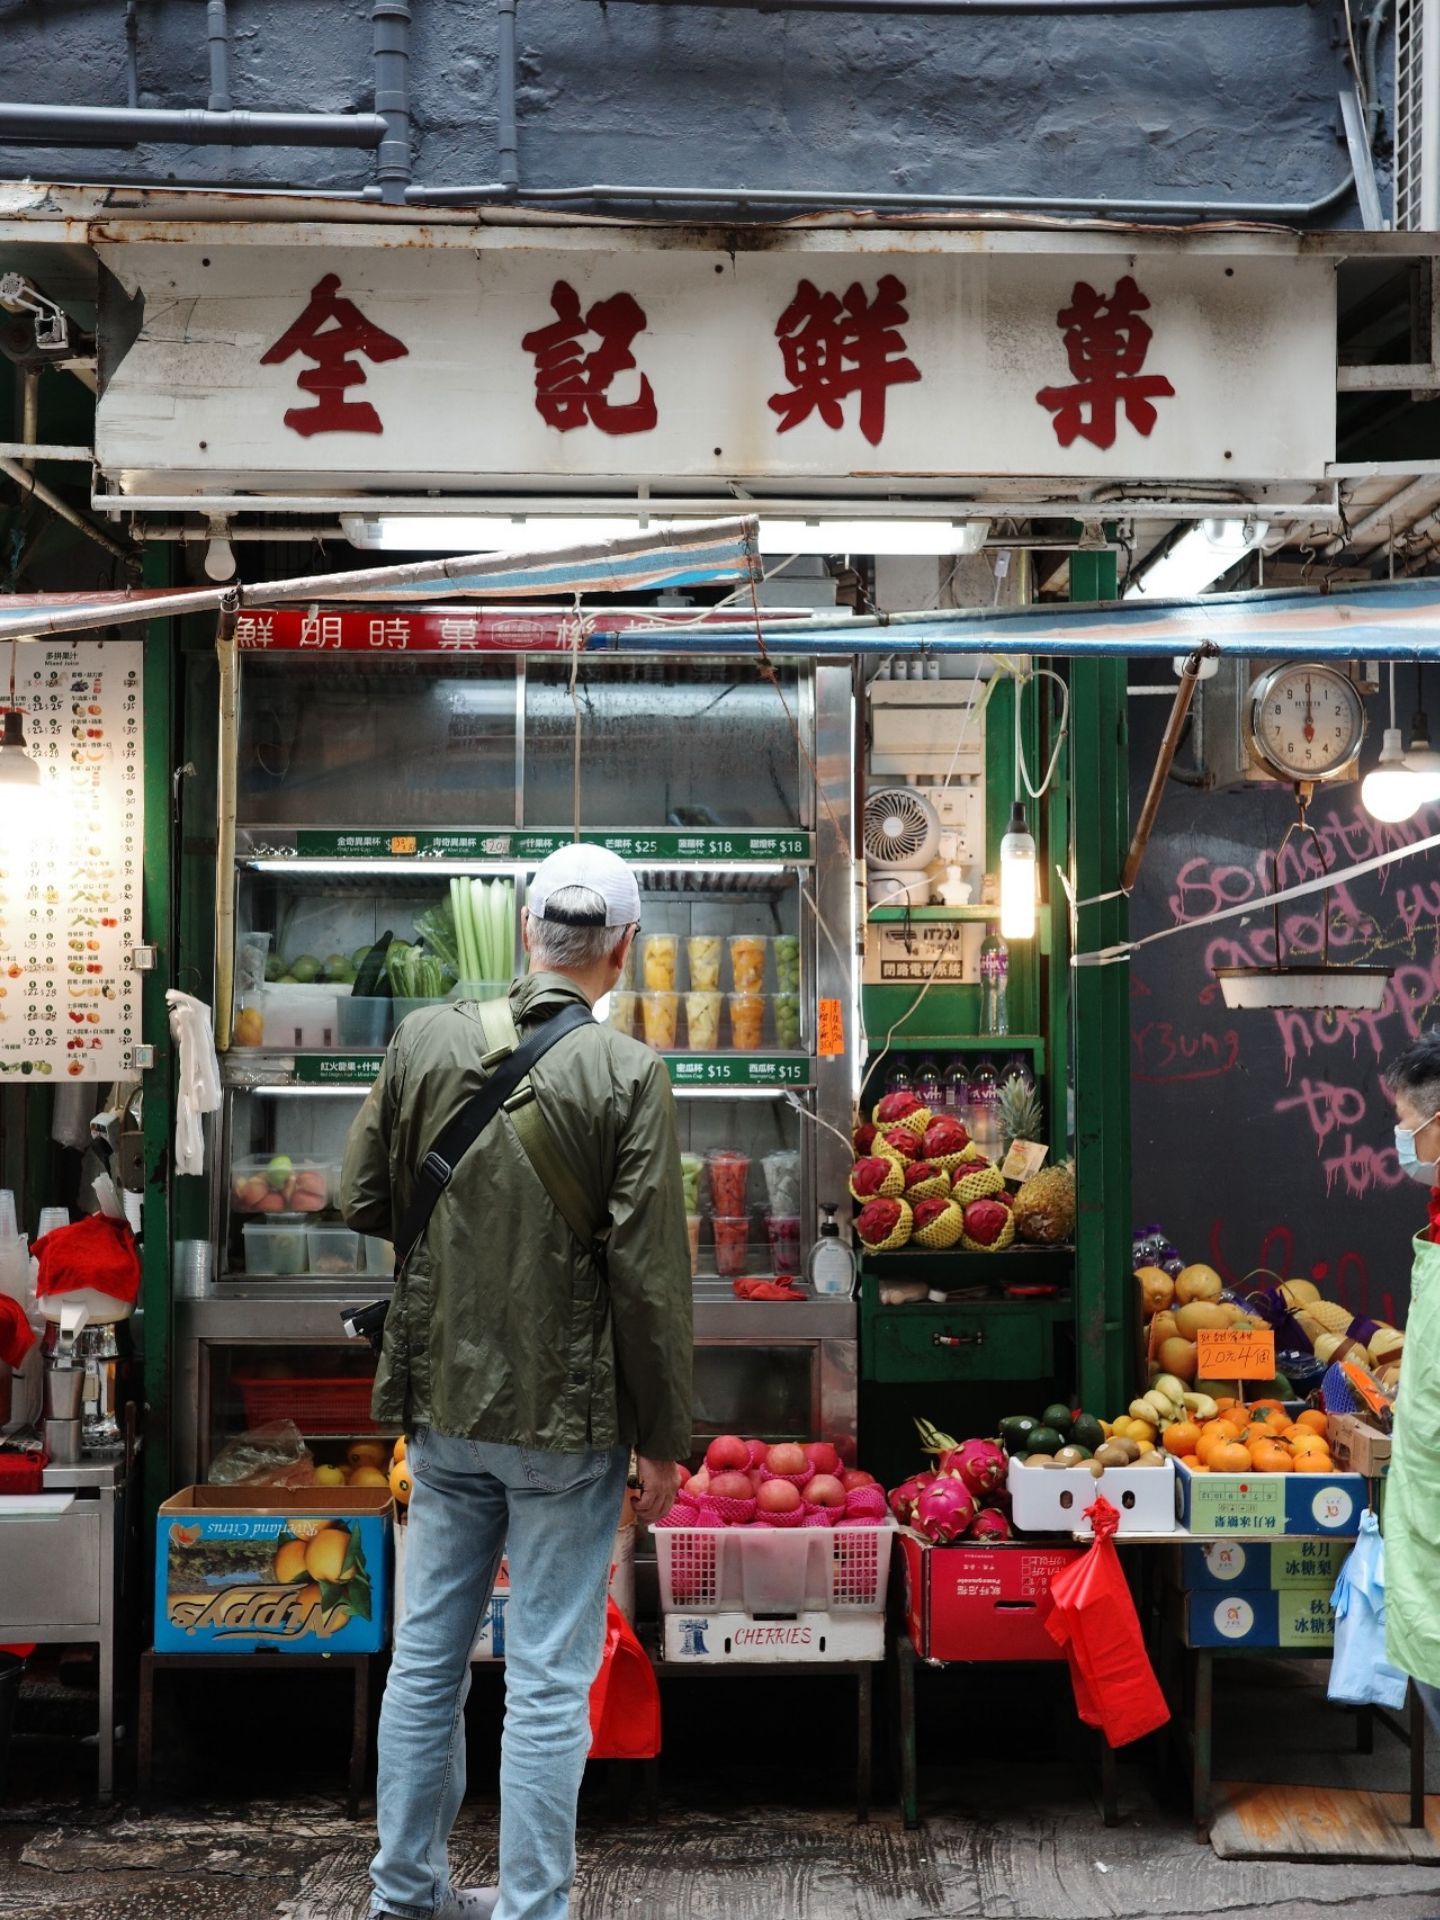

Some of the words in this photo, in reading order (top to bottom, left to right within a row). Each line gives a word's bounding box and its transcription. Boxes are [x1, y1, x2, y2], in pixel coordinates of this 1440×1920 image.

[260, 272, 1175, 449] 全記鮮菓
[635, 841, 657, 853] $25
[709, 841, 733, 853] $18
[779, 841, 802, 853] $18
[707, 1065, 731, 1078] $15
[778, 1065, 801, 1078] $15
[207, 1521, 248, 1535] Citrus
[252, 1522, 318, 1539] Riverland
[1301, 1542, 1331, 1558] 秋月
[1285, 1560, 1332, 1576] 冰糖梨
[735, 1626, 813, 1646] CHERRIES
